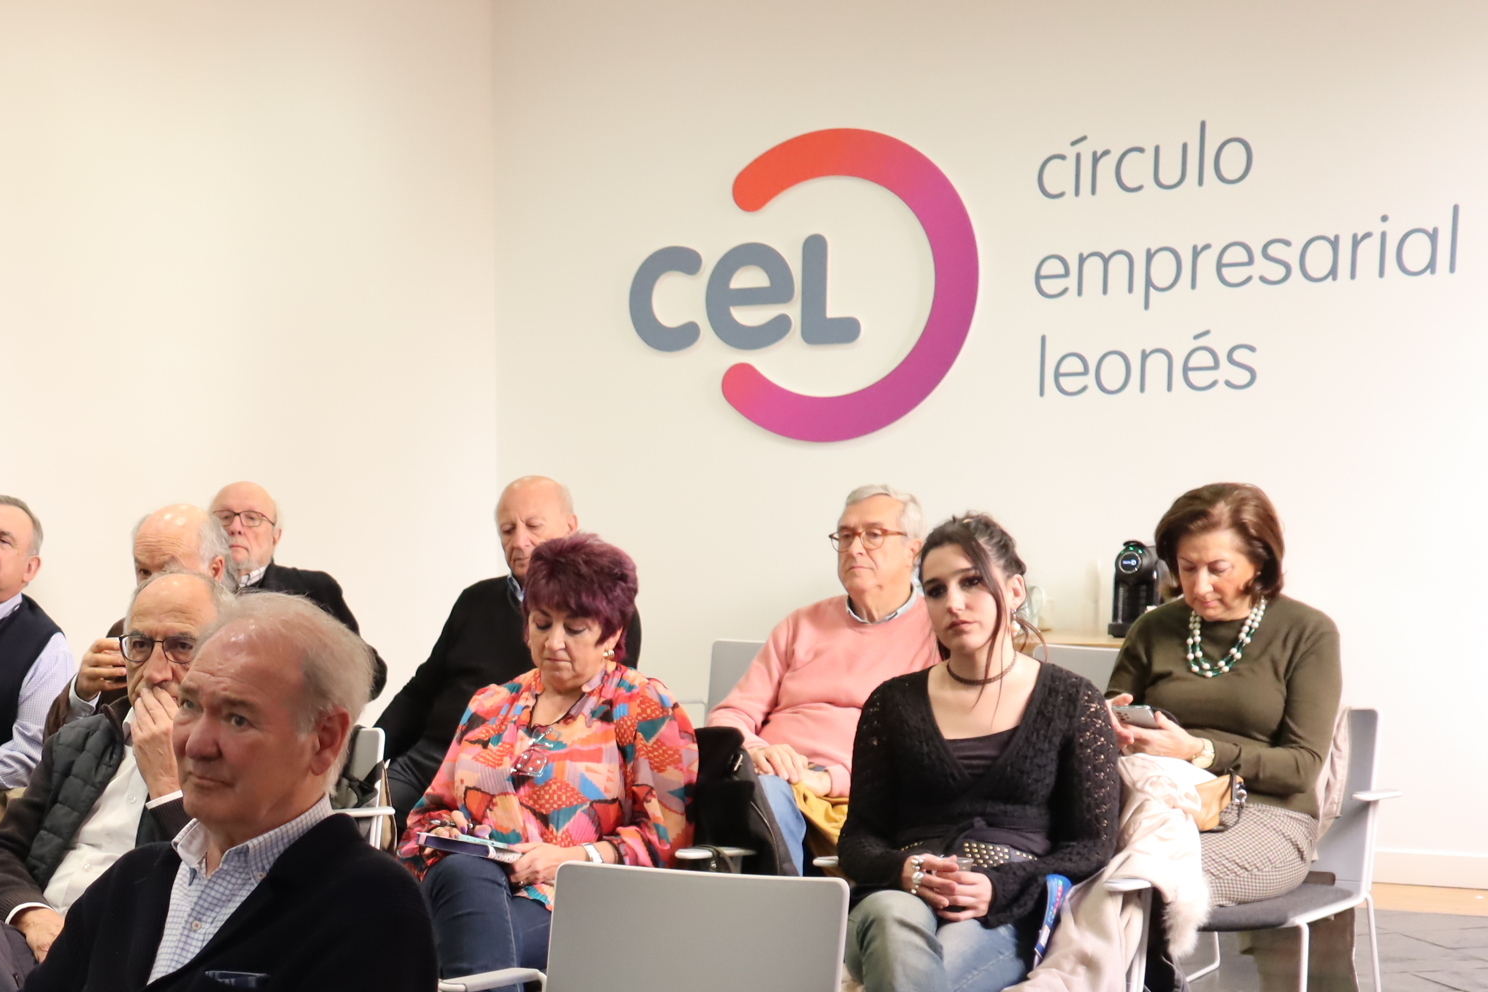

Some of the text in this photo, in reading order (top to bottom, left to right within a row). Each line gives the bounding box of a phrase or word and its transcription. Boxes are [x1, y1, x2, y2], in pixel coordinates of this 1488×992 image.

[1037, 119, 1254, 200] círculo
[1034, 203, 1460, 311] empresarial
[1039, 329, 1258, 398] leonés
